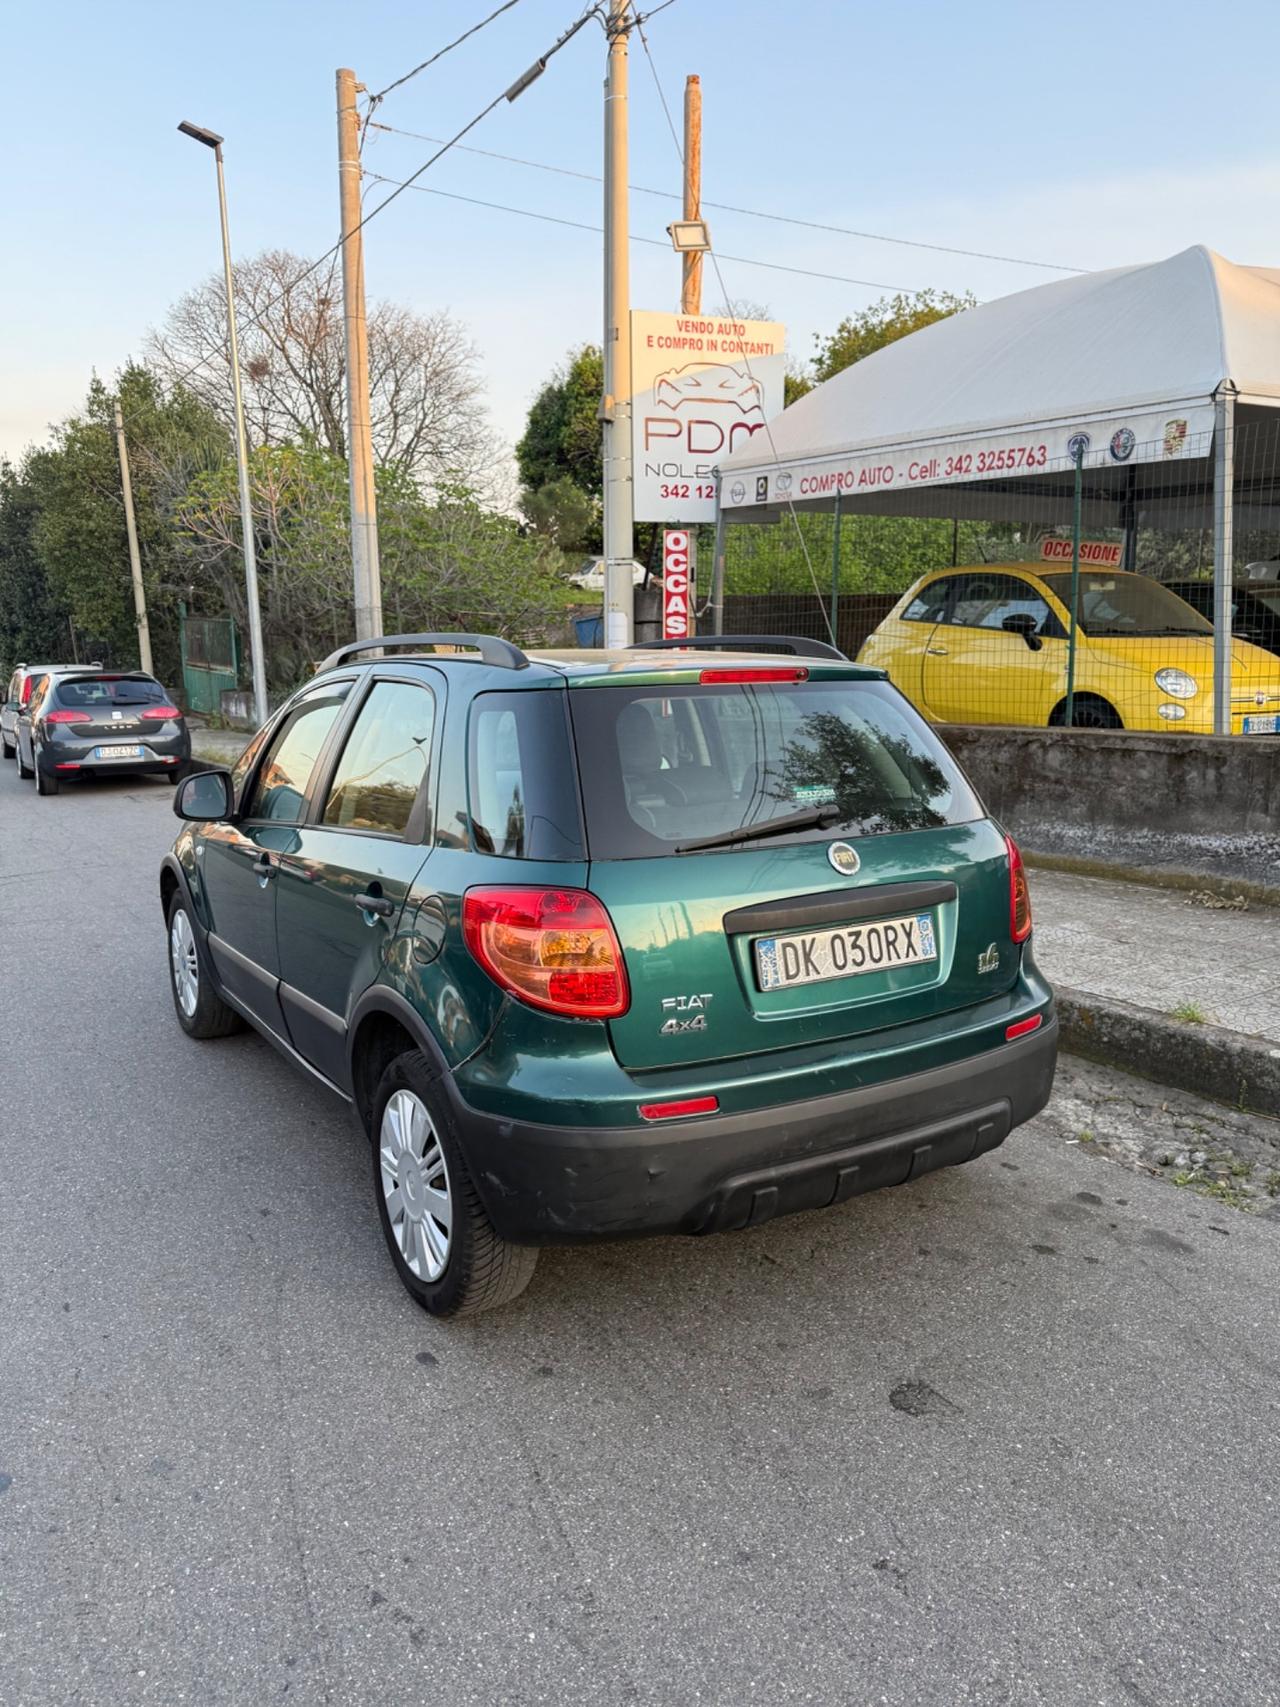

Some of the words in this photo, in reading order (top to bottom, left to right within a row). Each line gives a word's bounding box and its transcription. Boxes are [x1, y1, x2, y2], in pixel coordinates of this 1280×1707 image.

[677, 320, 714, 335] VENDO
[717, 323, 746, 337] AUTO
[647, 335, 654, 347] E
[657, 336, 704, 351] COMPRO
[707, 339, 718, 352] IN
[721, 340, 774, 355] CONTANTI
[800, 467, 854, 495] COMPRO
[858, 463, 894, 489] AUTO
[908, 459, 941, 481] Cell:
[945, 454, 972, 476] 342
[976, 445, 1048, 473] 3255763
[660, 484, 689, 498] 342
[696, 485, 719, 499] 12
[666, 532, 687, 640] OCCAS
[781, 936, 821, 981] DK
[830, 921, 918, 971] 030RX
[661, 993, 714, 1013] FIAT
[660, 1014, 708, 1034] 4x4
